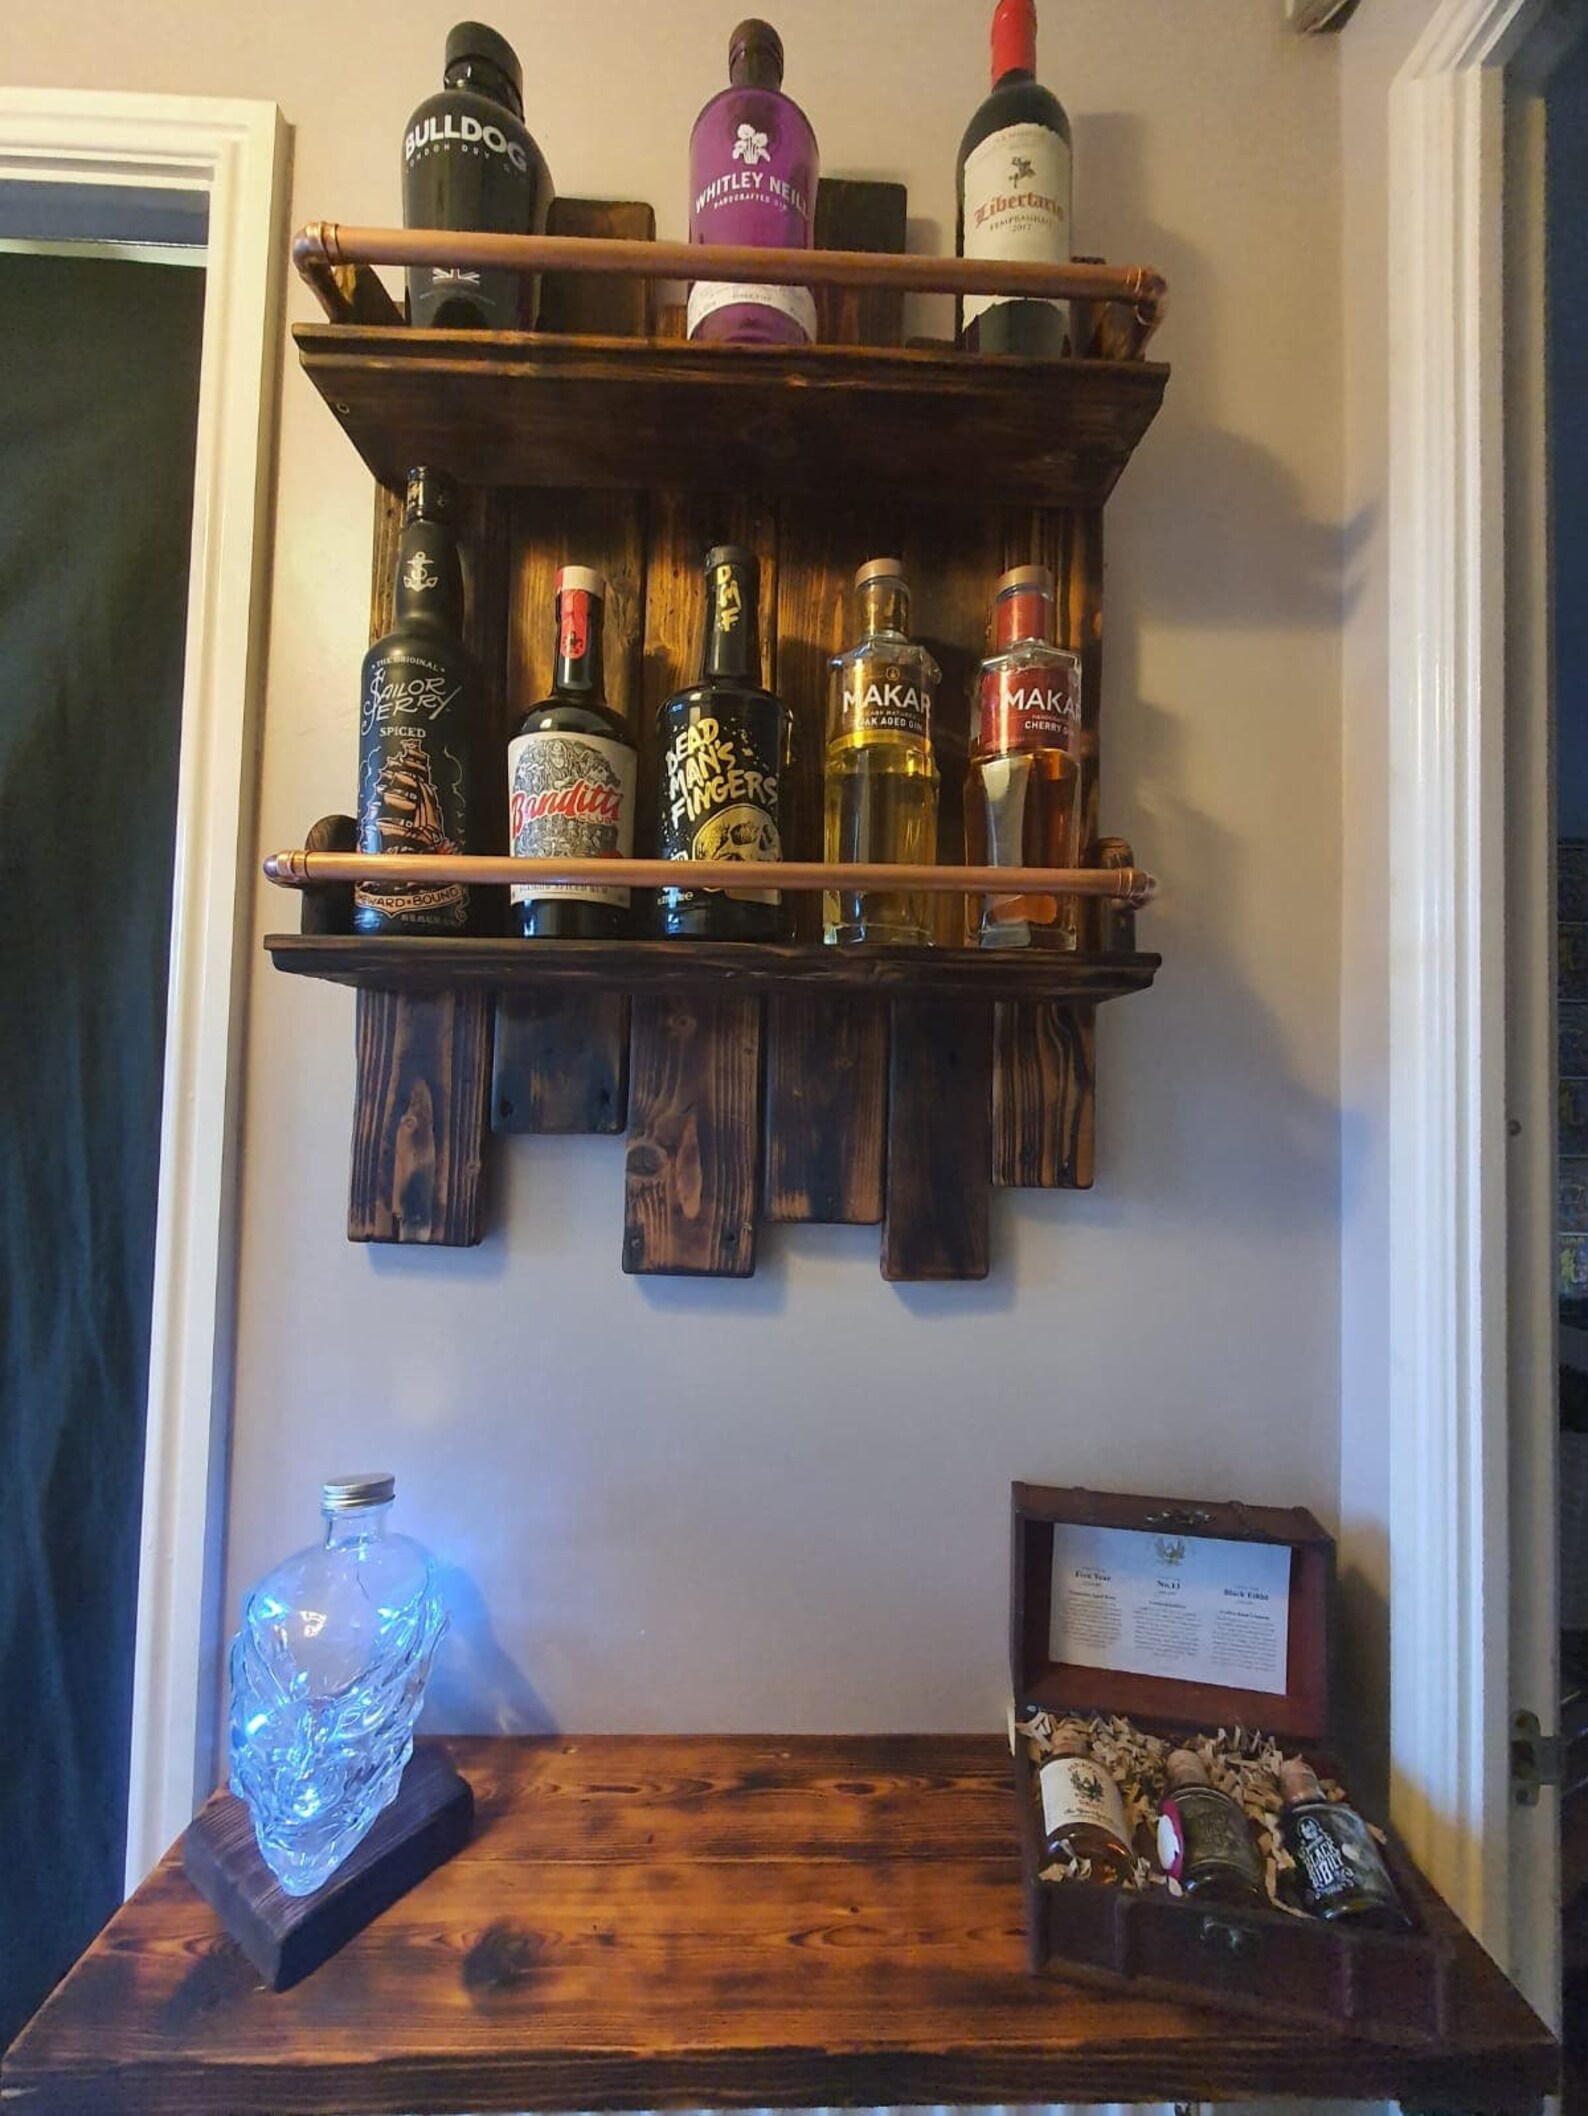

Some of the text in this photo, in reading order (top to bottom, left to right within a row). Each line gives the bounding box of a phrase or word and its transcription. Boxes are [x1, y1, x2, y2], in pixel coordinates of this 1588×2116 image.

[405, 114, 527, 173] BULLDOG
[696, 171, 763, 214] WHITLEY
[370, 667, 446, 707] SAILOR
[361, 686, 462, 736] JERRY
[379, 726, 426, 738] SPICED
[1025, 720, 1062, 733] CHERRY
[665, 718, 719, 777] DEAD
[669, 741, 736, 801] MAN'S
[670, 769, 778, 830] FINGERS
[413, 887, 459, 906] BOUND
